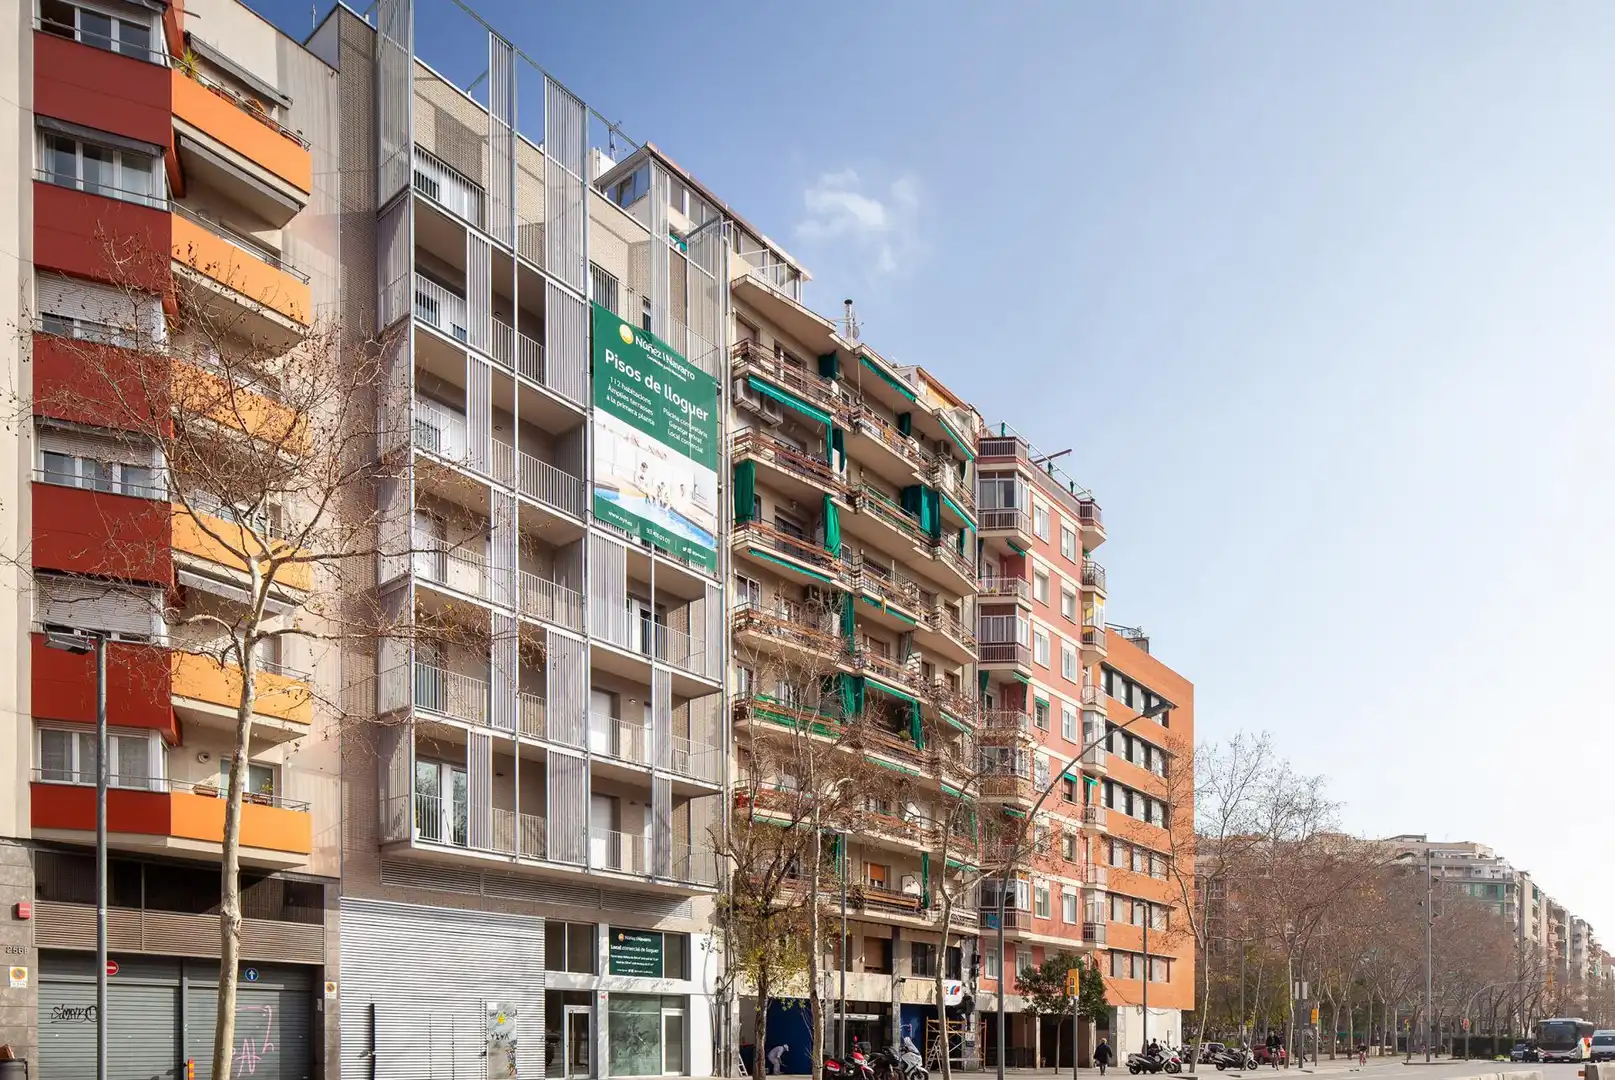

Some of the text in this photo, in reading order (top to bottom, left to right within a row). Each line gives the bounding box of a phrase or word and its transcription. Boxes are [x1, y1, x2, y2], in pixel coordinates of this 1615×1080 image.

[635, 335, 662, 359] Núñez
[665, 354, 696, 380] Navarro
[605, 348, 641, 382] Pisos
[644, 374, 661, 394] de
[664, 383, 709, 421] lloguer
[621, 382, 652, 405] habitacions
[616, 401, 638, 417] primera
[637, 412, 656, 426] planta
[629, 398, 654, 416] terrasses
[662, 407, 680, 422] Piscina
[667, 428, 680, 441] Local
